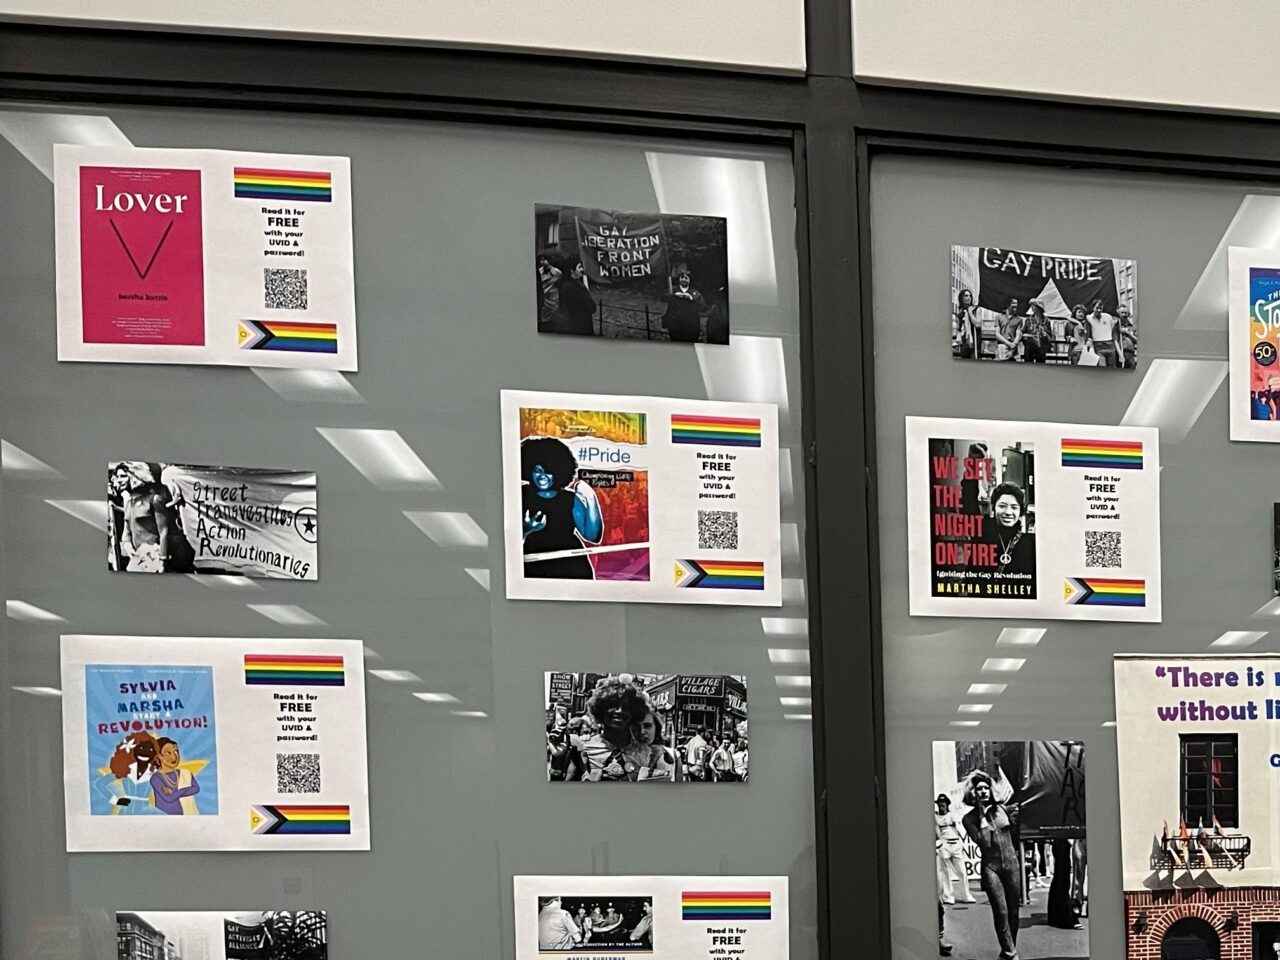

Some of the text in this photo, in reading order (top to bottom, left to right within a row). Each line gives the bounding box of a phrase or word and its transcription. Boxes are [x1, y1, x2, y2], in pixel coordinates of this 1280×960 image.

[96, 185, 188, 213] Lover
[598, 250, 652, 262] FRONT
[983, 248, 1102, 280] GAY PRIDE
[578, 447, 631, 463] #Pride
[702, 461, 731, 471] FREE
[193, 482, 248, 500] Street
[193, 500, 293, 526] Transvestites
[197, 518, 246, 540] Action
[935, 515, 984, 537] NIGHT
[201, 538, 310, 578] Revolutionaries
[935, 543, 998, 567] ON FIRE
[681, 677, 720, 686] VILLAGE
[1155, 666, 1239, 687] “There
[1247, 666, 1264, 687] is
[120, 680, 176, 694] SYLVIA
[682, 684, 716, 694] CIGARS
[117, 699, 184, 712] MARSHA
[1157, 701, 1258, 721] without
[98, 717, 208, 734] REVOLUTION!
[712, 936, 741, 945] FREE
